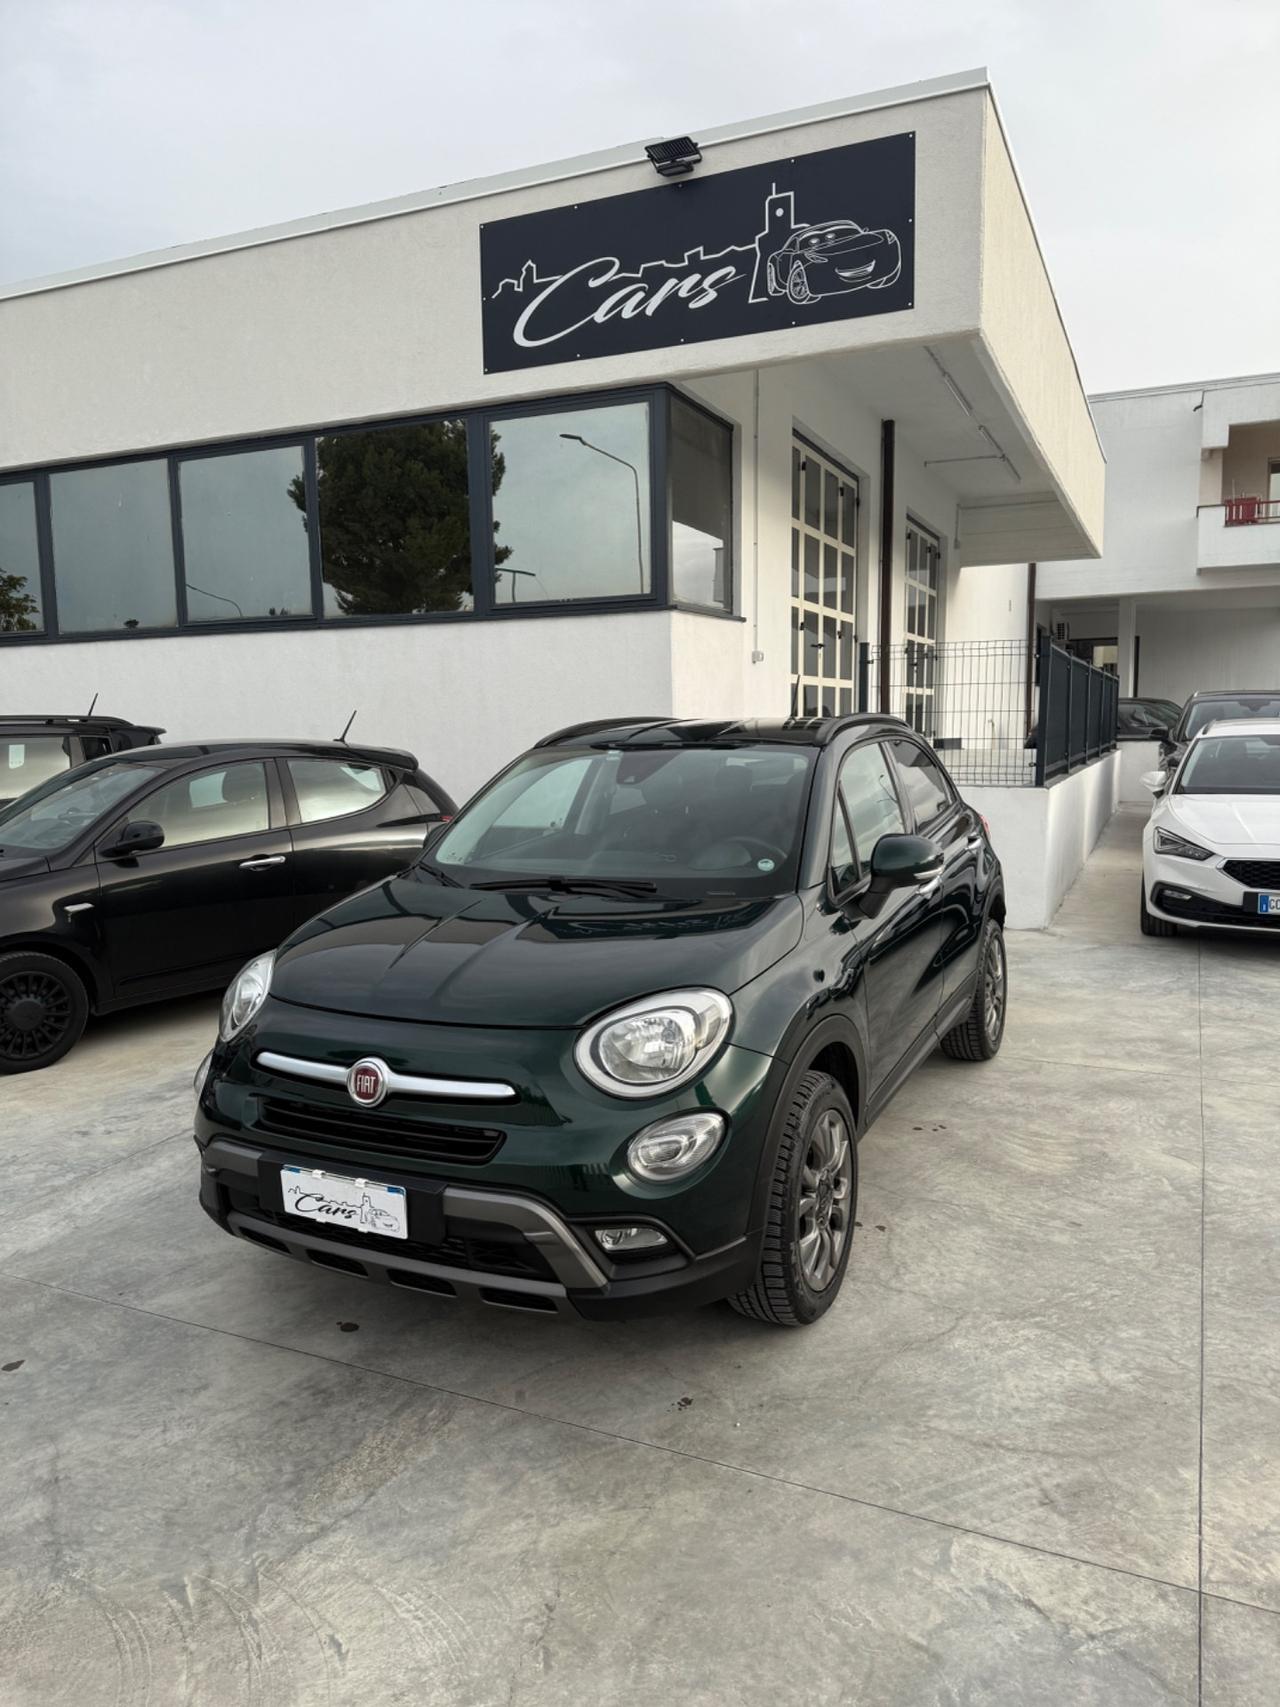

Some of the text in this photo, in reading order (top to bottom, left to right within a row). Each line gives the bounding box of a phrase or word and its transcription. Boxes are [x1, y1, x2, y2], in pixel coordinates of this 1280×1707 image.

[513, 256, 747, 347] Cars
[356, 1074, 376, 1094] FIAT
[295, 1193, 358, 1219] Cars
